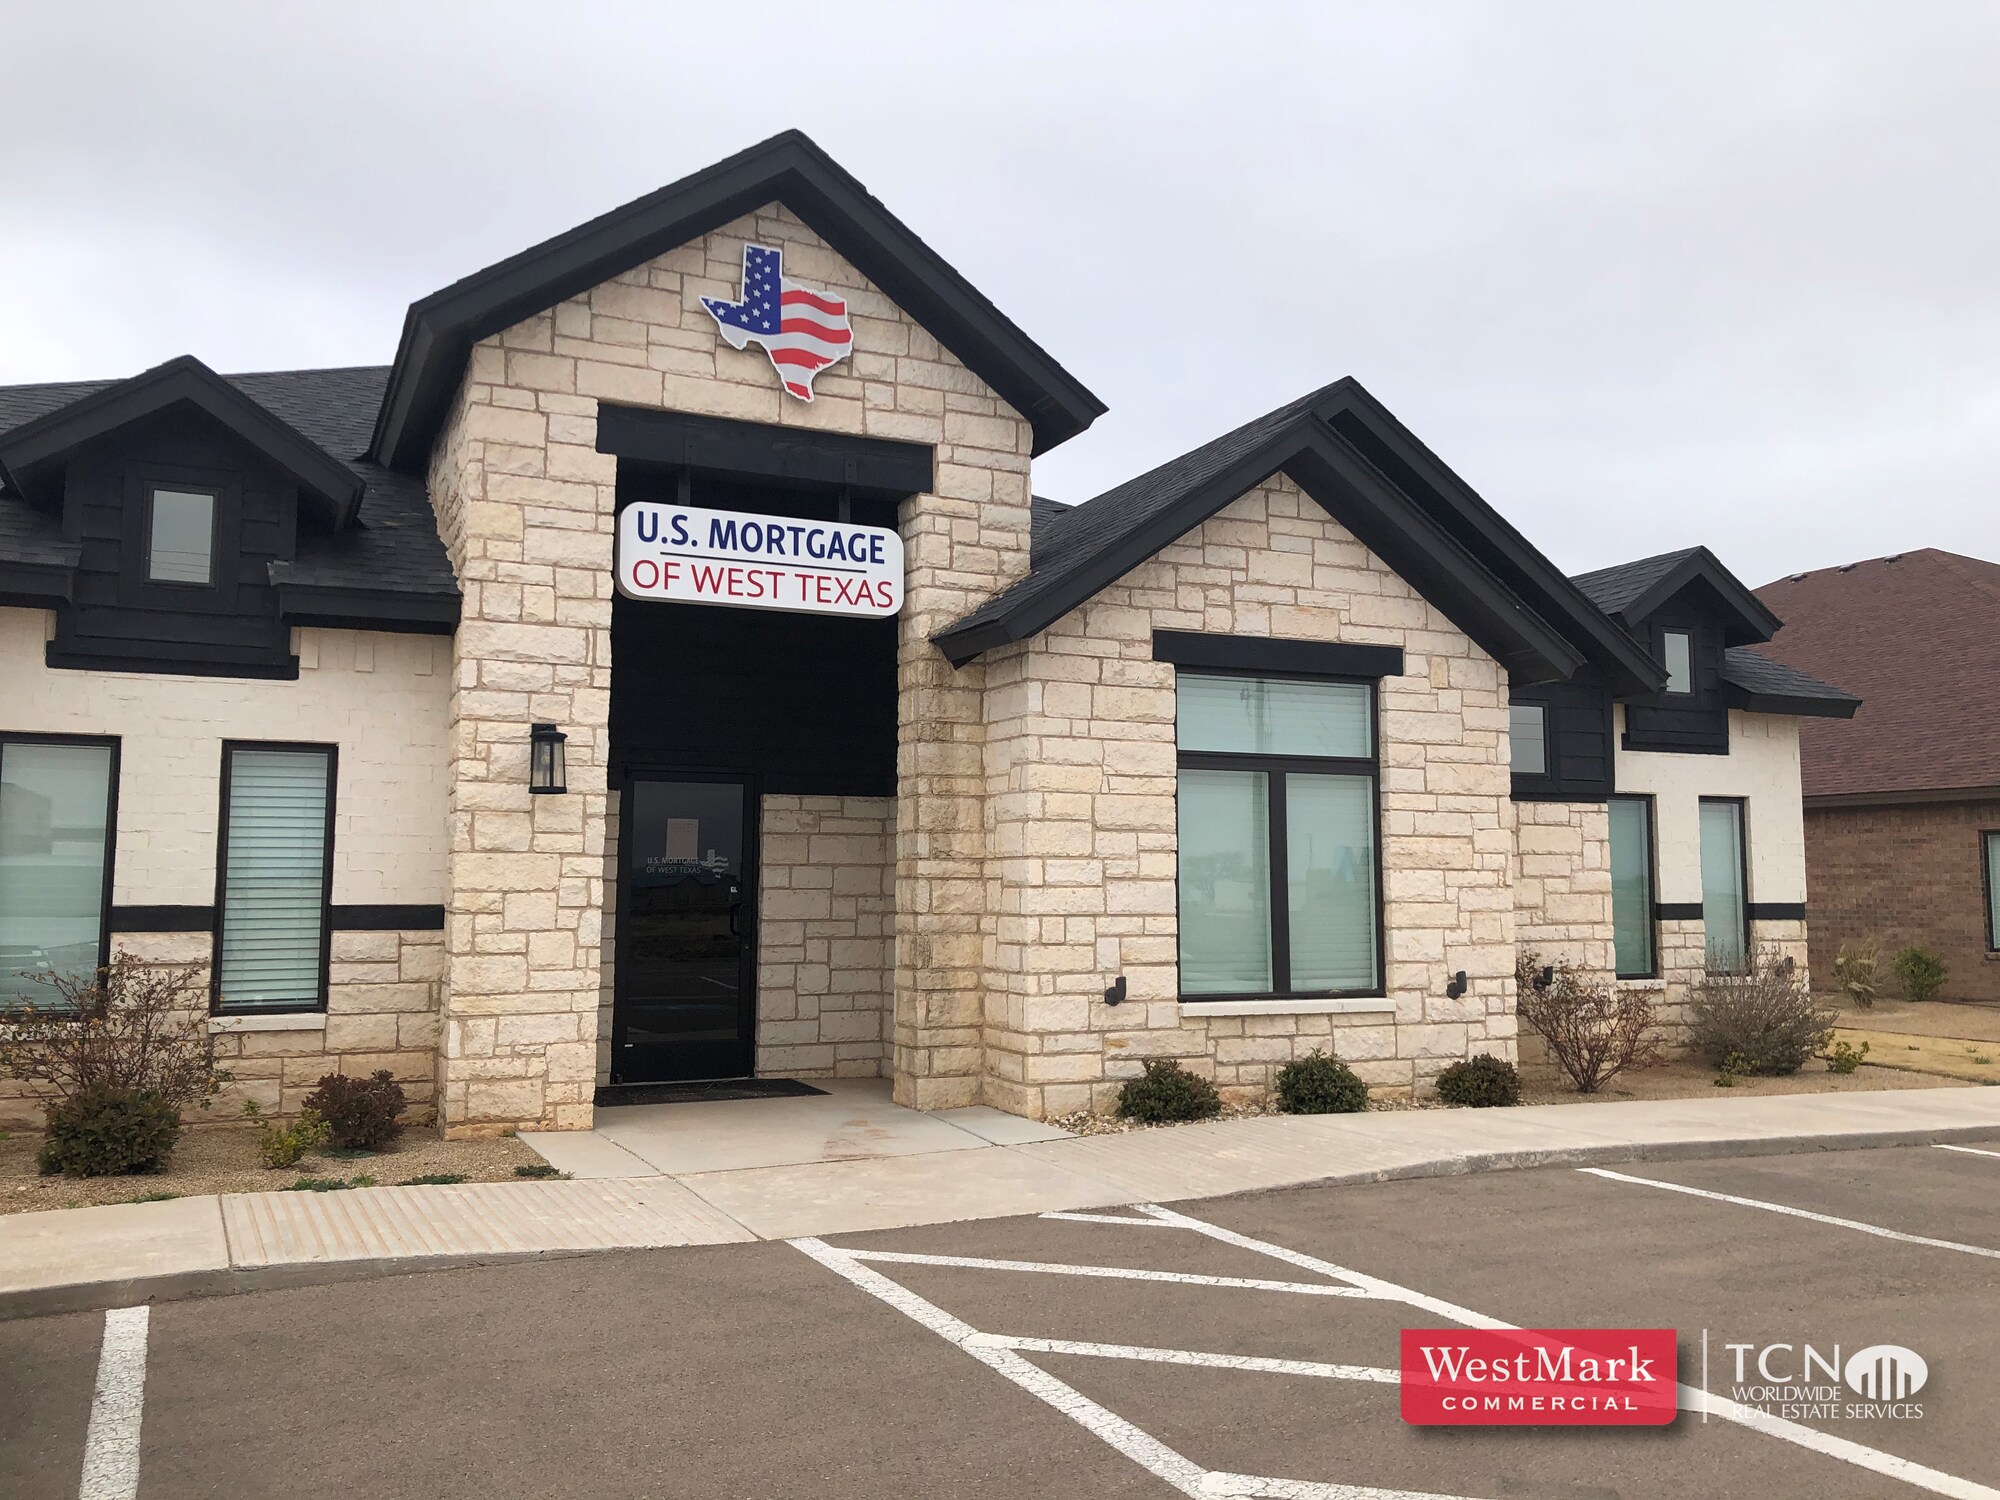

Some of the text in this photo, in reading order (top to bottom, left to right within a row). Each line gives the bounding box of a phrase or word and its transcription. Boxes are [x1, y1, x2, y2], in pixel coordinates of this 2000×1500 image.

[637, 510, 885, 564] U.S. MORTGAGE
[632, 559, 893, 608] OF WEST TEXAS
[658, 866, 677, 874] WEST
[661, 857, 700, 865] MORTGAGE
